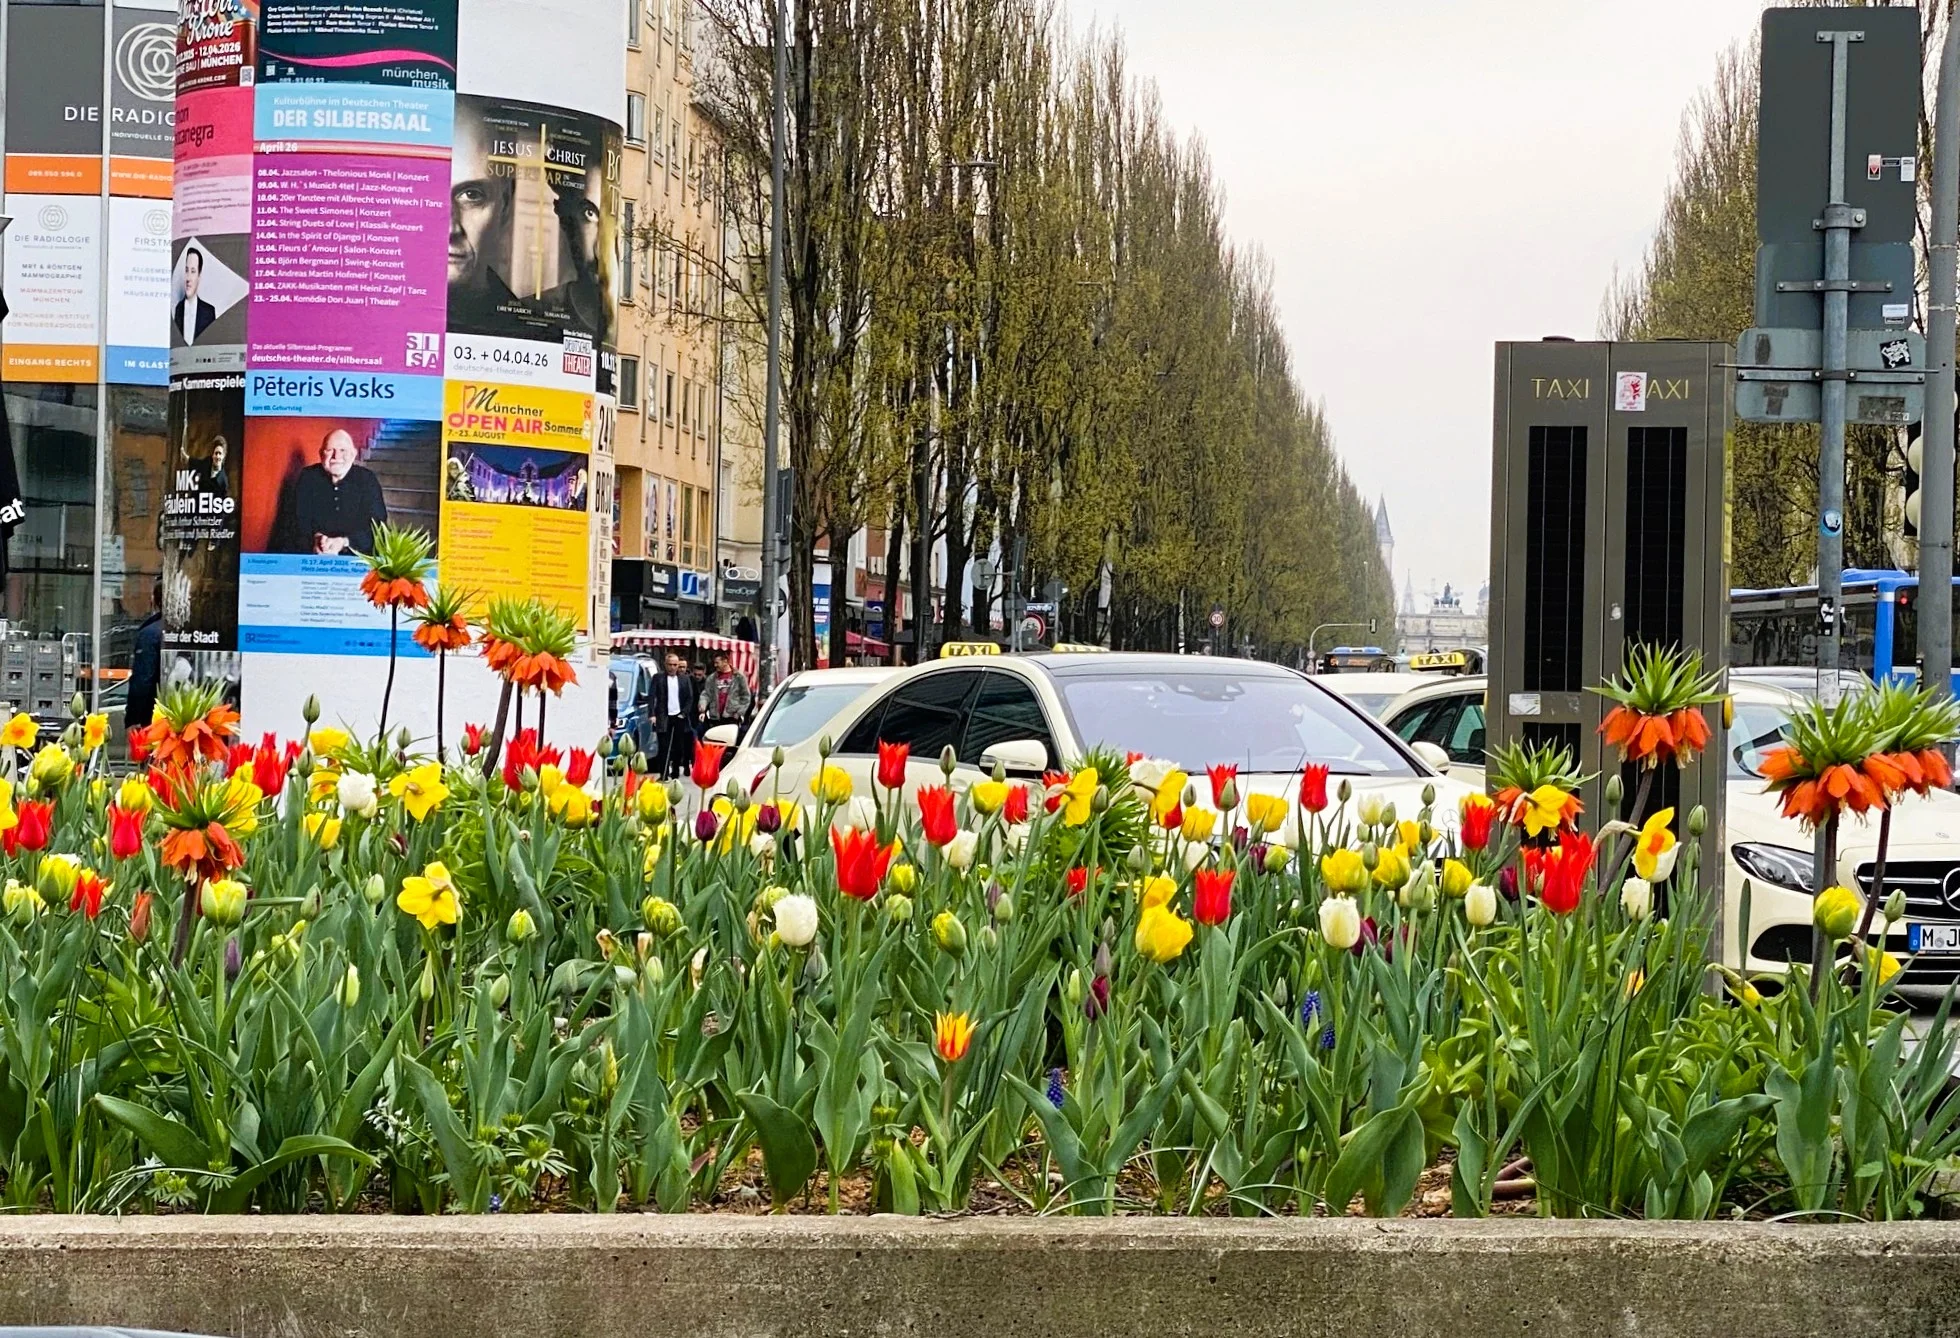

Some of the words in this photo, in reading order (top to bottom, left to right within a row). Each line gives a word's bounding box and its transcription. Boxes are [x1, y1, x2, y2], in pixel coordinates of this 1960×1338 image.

[187, 12, 233, 45] Krone
[201, 54, 243, 68] MÜNCHEN
[382, 67, 438, 80] münchen
[412, 78, 449, 90] musik
[274, 97, 326, 106] Kulturbühne
[342, 98, 390, 108] Deutschen
[393, 100, 429, 111] Theater
[64, 106, 99, 122] DIE
[273, 110, 307, 127] DER
[314, 110, 431, 132] SILBERSAAL
[260, 142, 284, 154] April
[493, 140, 532, 157] JESUS
[547, 148, 586, 166] CHRIST
[281, 169, 317, 177] Jazzsalon
[323, 170, 367, 178] Thelonious
[397, 172, 429, 182] Konzert
[309, 182, 337, 190] Munich
[297, 194, 325, 202] Tanztee
[341, 195, 375, 204] Albrecht
[392, 198, 419, 206] Weech
[424, 200, 443, 208] Tanz
[360, 209, 391, 217] Konzert
[280, 219, 301, 228] String
[34, 236, 90, 244] RADIOLOGIE
[301, 232, 322, 241] Spirit
[333, 233, 361, 244] Django
[367, 234, 399, 243] Konzert
[278, 257, 298, 265] Björn
[299, 258, 339, 267] Bergmann
[22, 272, 82, 280] MAMMOGRAPHIE
[374, 273, 406, 281] Konzert
[383, 286, 401, 295] Zapf
[407, 287, 427, 295] Tanz
[328, 296, 343, 304] Don
[344, 296, 364, 305] Juan
[370, 297, 400, 306] Theater
[9, 358, 52, 366] EINGANG
[54, 359, 91, 367] RECHTS
[252, 354, 382, 365] deutsches-theater.de/silbersaal
[454, 346, 476, 360] 03.
[493, 349, 548, 367] 04.04.26
[124, 360, 136, 368] IM
[564, 354, 591, 376] THEATER
[183, 375, 246, 391] Kammerspiele
[253, 376, 324, 397] Pēteris
[329, 377, 394, 399] Vasks
[1531, 378, 1589, 399] TAXI
[466, 385, 543, 417] Münchner
[448, 413, 507, 431] OPEN
[512, 419, 542, 434] AIR
[544, 422, 582, 435] Sommer
[473, 431, 506, 439] AUGUST
[176, 470, 200, 492] MK:
[198, 492, 235, 514] Else
[210, 529, 235, 538] Riedler
[180, 631, 192, 642] der
[193, 630, 219, 644] Stadt
[951, 645, 991, 656] TAXI
[1418, 654, 1456, 665] TAXI
[1923, 928, 1933, 947] M
